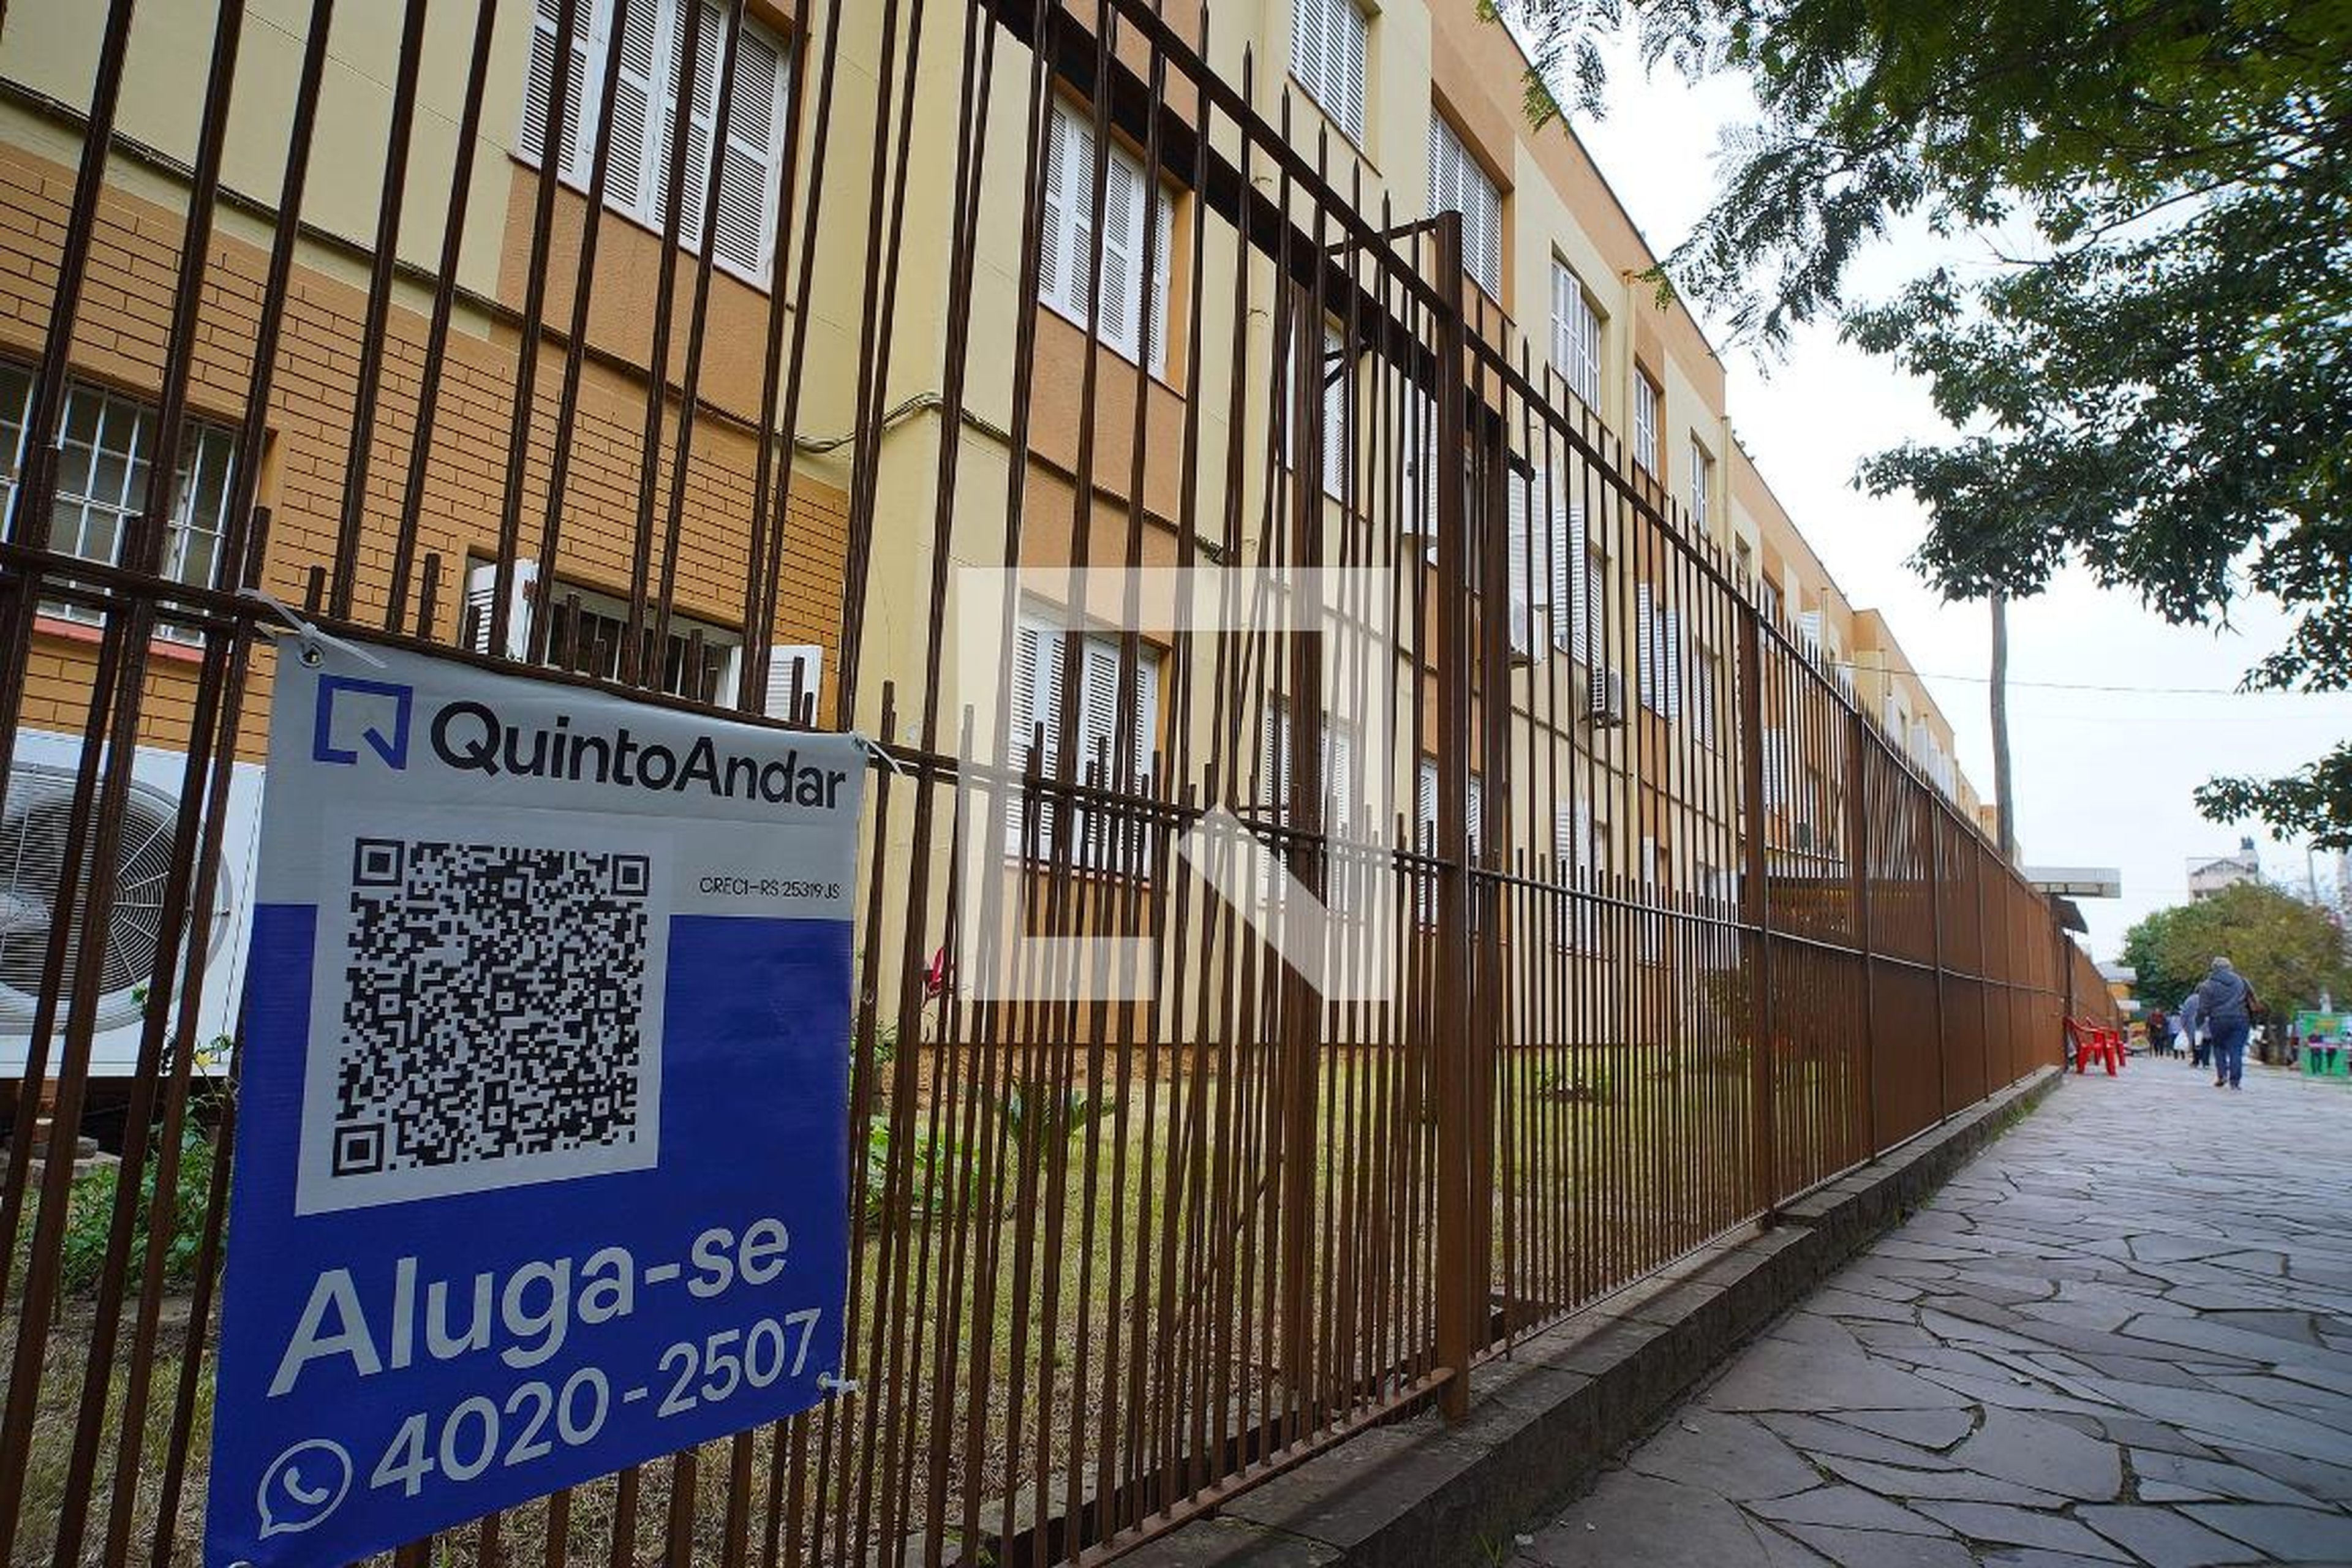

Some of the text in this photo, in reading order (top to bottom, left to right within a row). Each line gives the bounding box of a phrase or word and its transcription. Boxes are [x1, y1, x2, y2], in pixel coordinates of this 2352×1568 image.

[430, 701, 846, 809] QuintoAndar
[699, 877, 778, 897] CRECI-RS
[267, 1218, 789, 1396] Aluga-se
